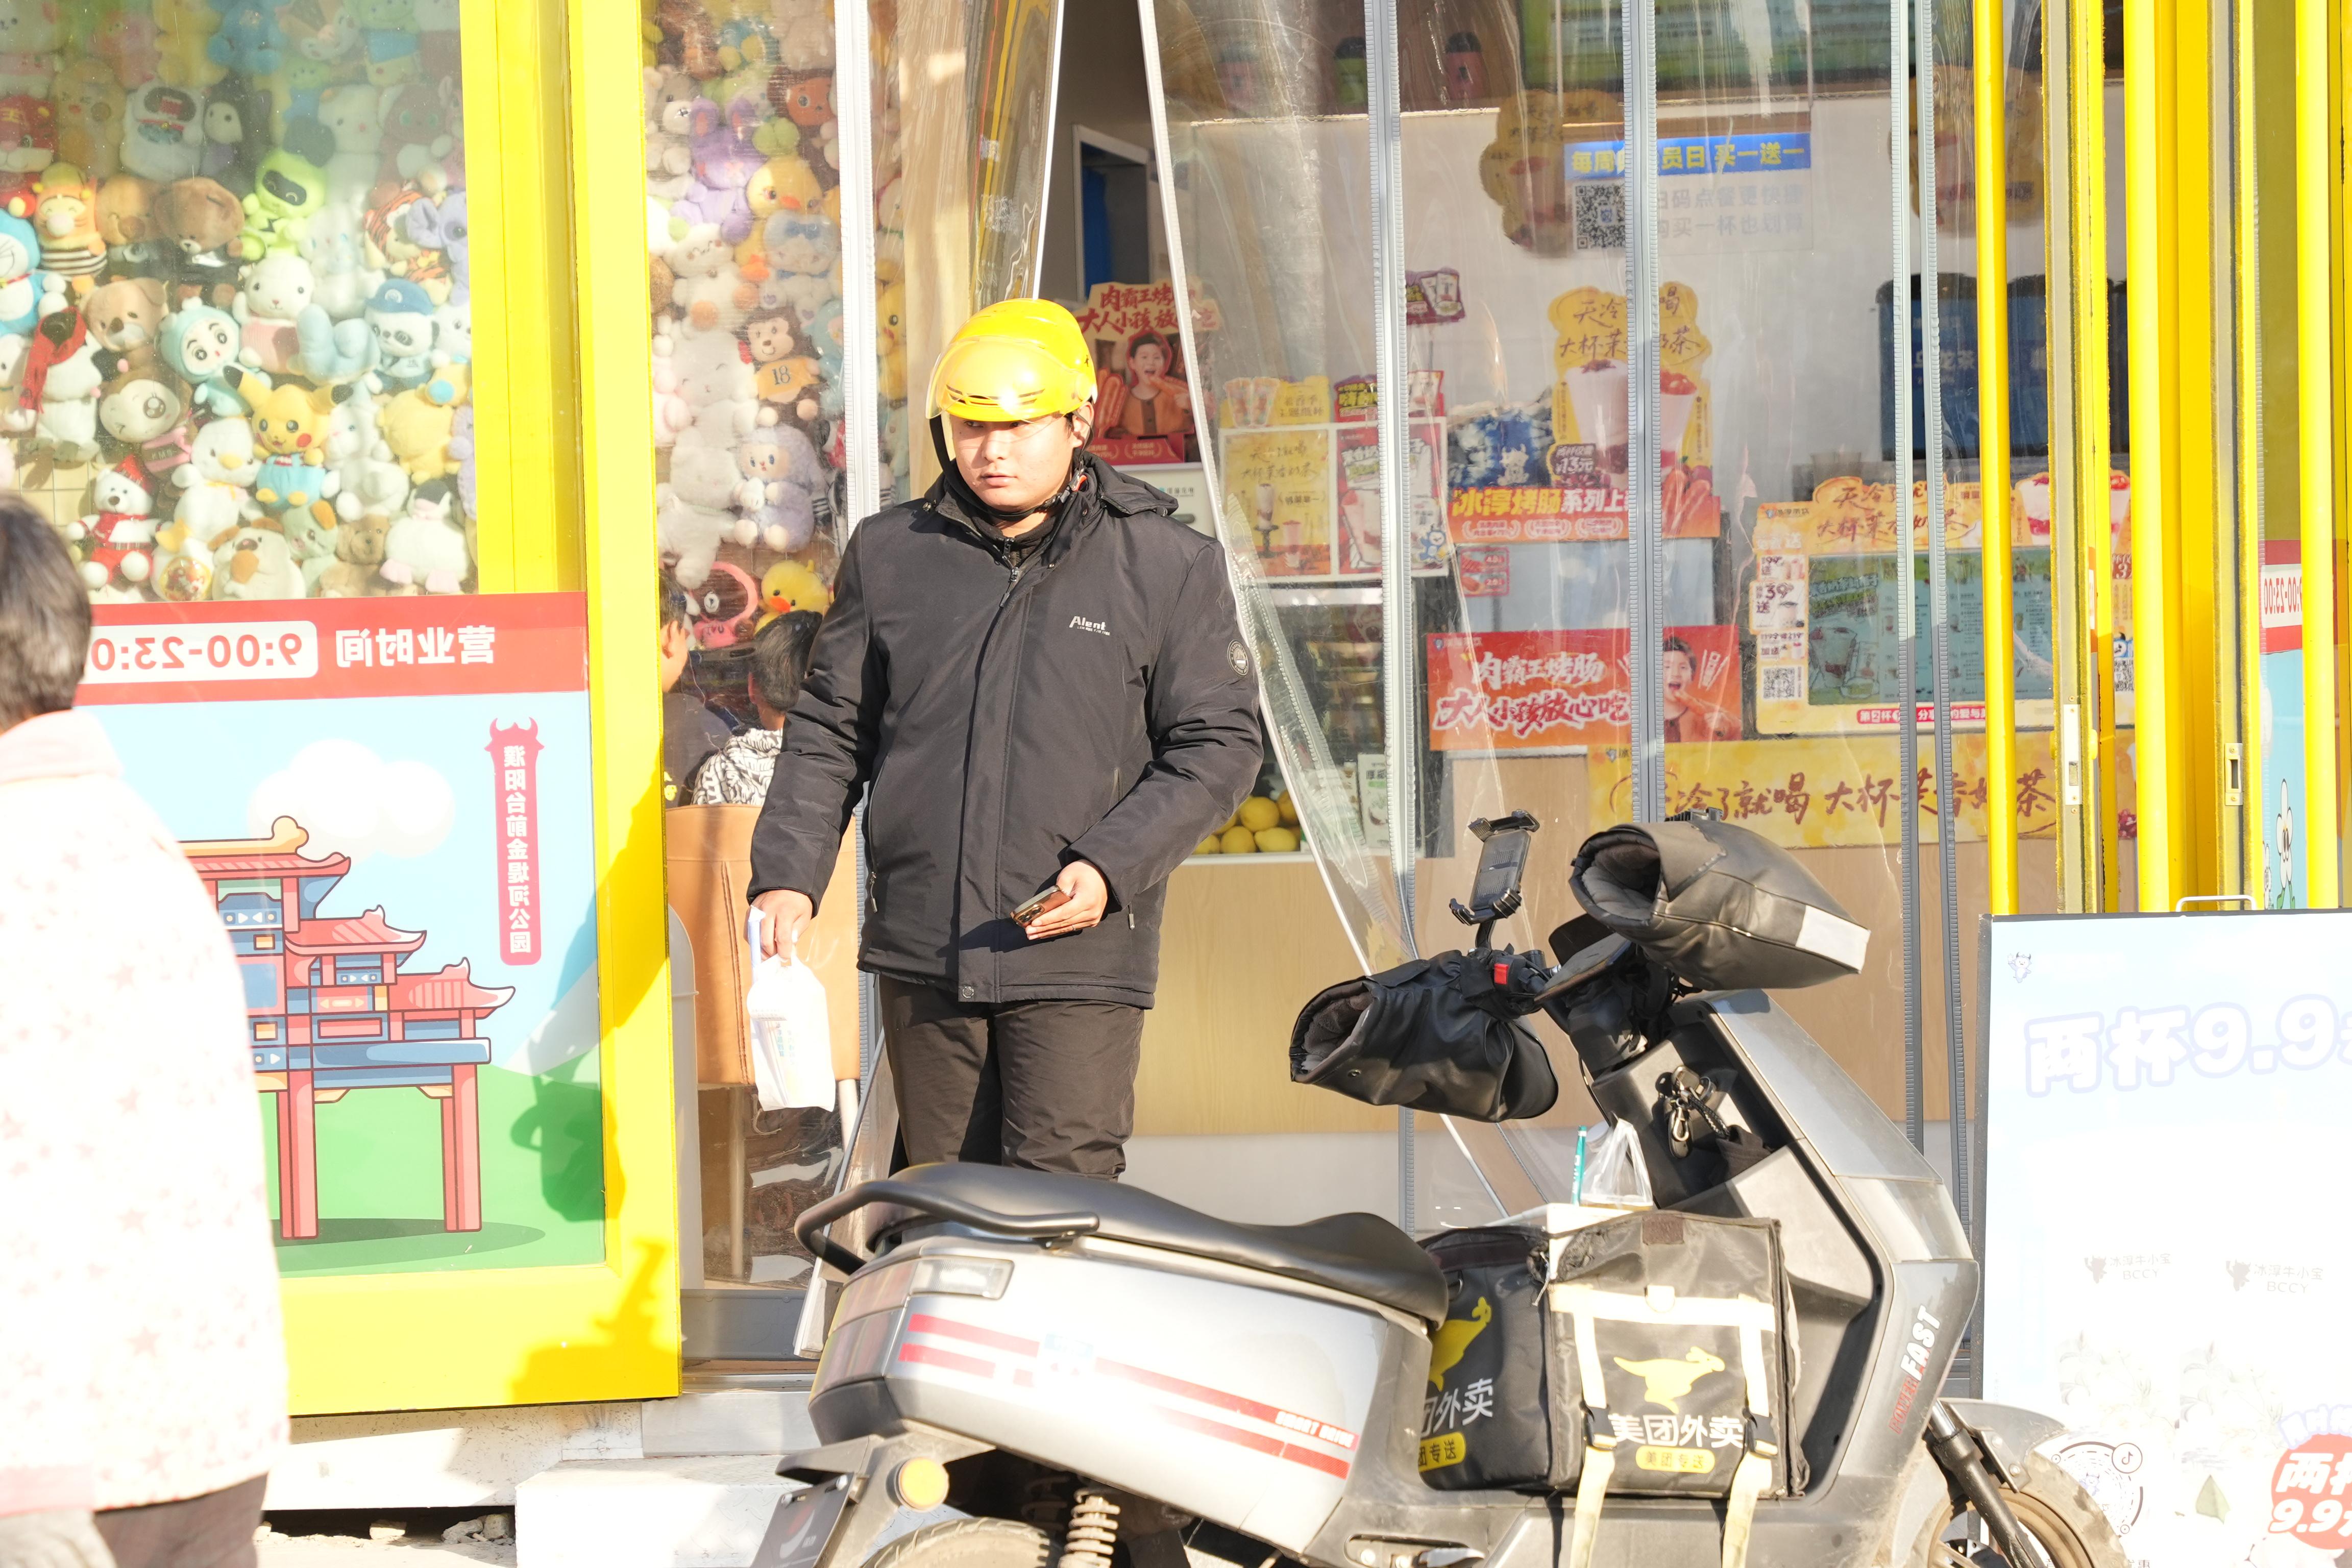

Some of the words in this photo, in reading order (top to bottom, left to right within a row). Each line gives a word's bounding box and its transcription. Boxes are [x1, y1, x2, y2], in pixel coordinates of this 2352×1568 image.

[1100, 282, 1195, 311] 肉霸王烤
[772, 365, 791, 385] 18
[1453, 487, 1630, 517] 冰淳烤肠系列上
[1472, 652, 1604, 690] 肉霸王烤肠
[1433, 688, 1630, 739] 大人小孩放心吃
[2024, 994, 2352, 1098] 两杯9.9
[2123, 1268, 2160, 1280] BCCY
[2267, 1281, 2309, 1294] BCCY
[1900, 1305, 1940, 1381] FAST
[1608, 1413, 1744, 1449] 美团外卖
[1646, 1451, 1704, 1468] 美团专送
